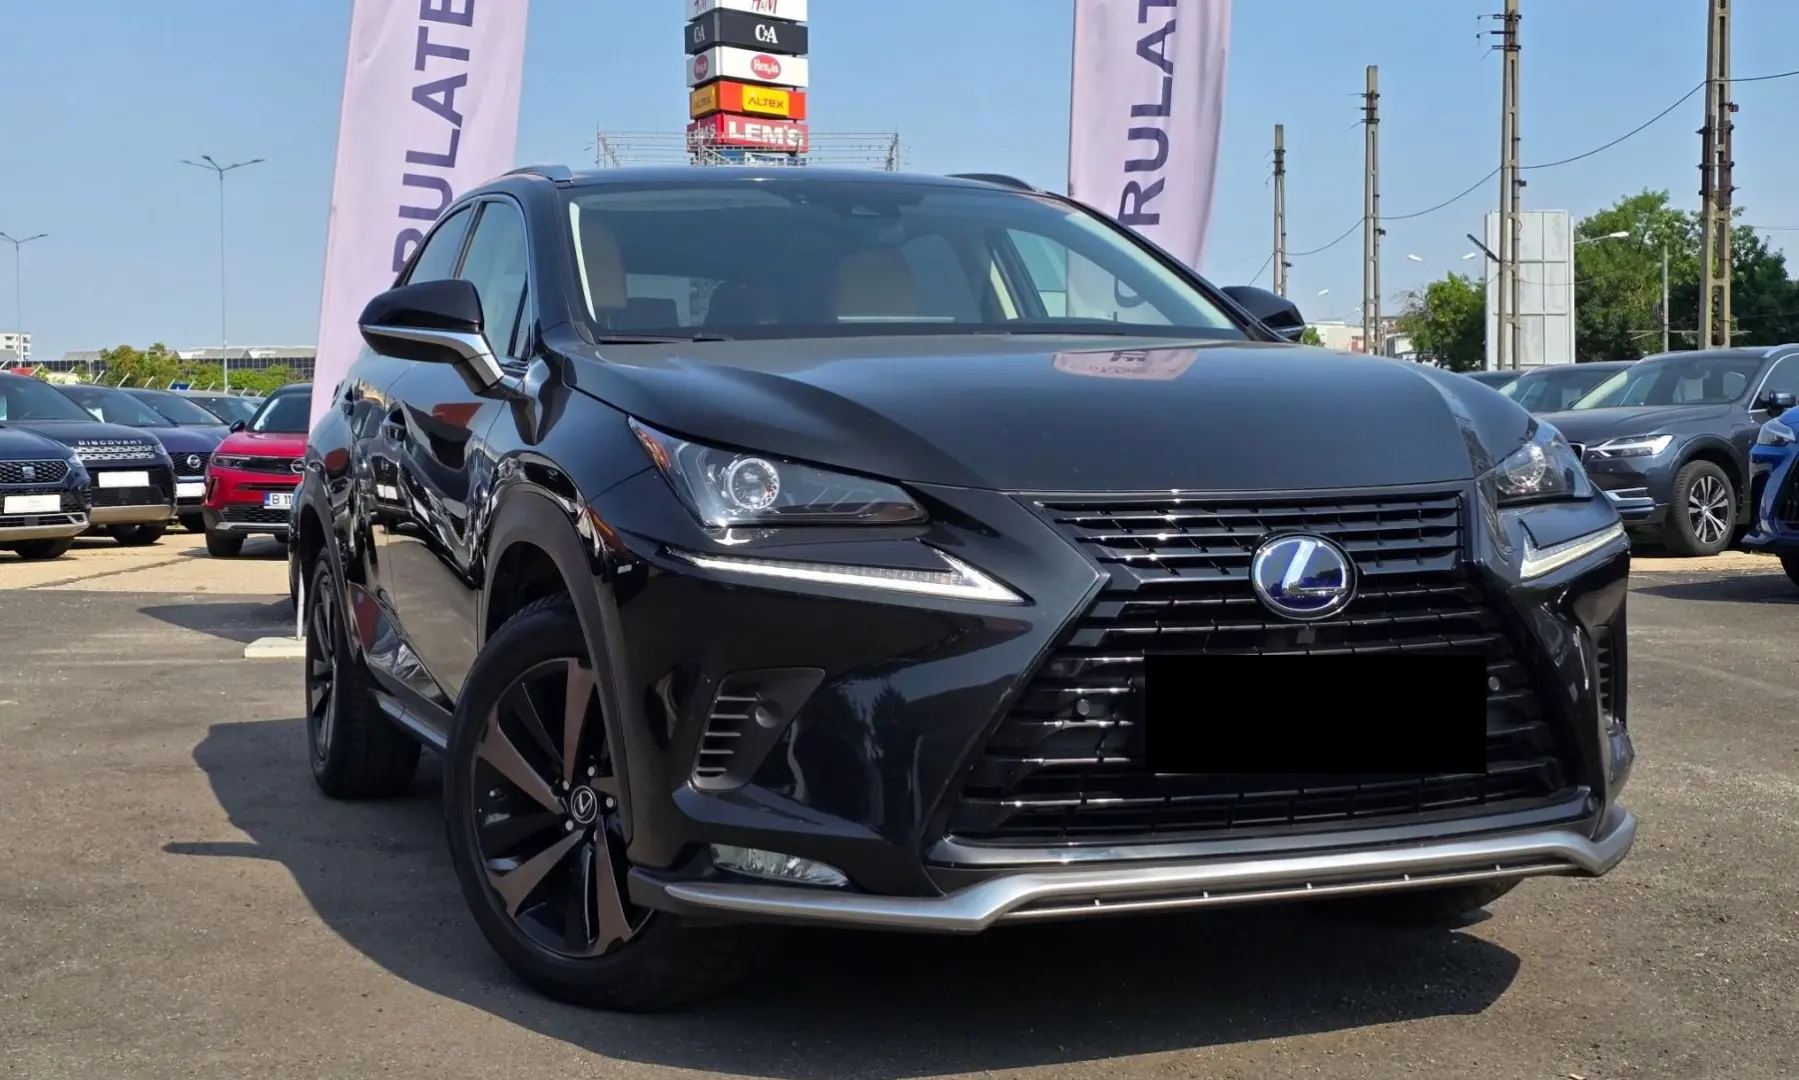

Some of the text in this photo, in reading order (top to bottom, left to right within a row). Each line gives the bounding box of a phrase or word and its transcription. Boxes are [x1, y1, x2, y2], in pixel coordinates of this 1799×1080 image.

[755, 24, 778, 43] C&A
[747, 96, 784, 109] ALTEX
[728, 121, 803, 146] LEM'S
[272, 494, 280, 505] B
